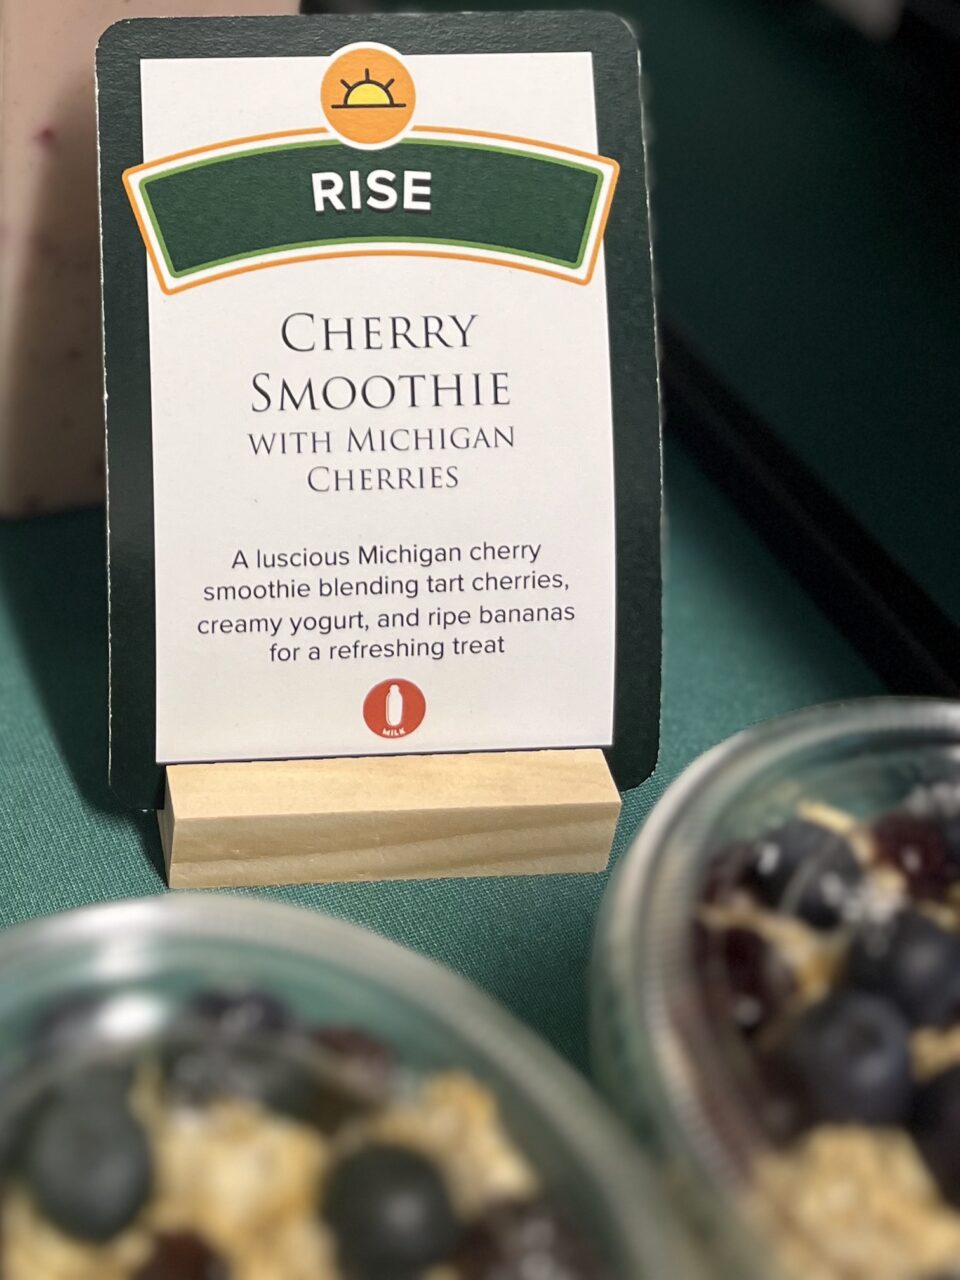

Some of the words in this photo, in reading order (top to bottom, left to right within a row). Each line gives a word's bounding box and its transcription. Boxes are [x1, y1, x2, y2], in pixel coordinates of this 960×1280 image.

[312, 170, 433, 213] RISE
[281, 312, 477, 353] CHERRY
[251, 372, 510, 413] SMOOTHIE
[248, 431, 331, 455] WITH
[347, 426, 514, 453] MICHIGAN
[307, 466, 459, 492] CHERRIES
[231, 549, 249, 569] A
[257, 547, 350, 569] luscious
[358, 544, 461, 568] Michigan
[469, 541, 542, 564] cherry
[203, 579, 311, 601] smoothie
[319, 575, 419, 599] blending
[426, 574, 465, 594] tart
[471, 570, 569, 592] cherries,
[197, 617, 283, 637] creamy
[289, 610, 369, 637] yogurt,
[377, 607, 419, 628] and
[428, 607, 471, 630] ripe
[479, 605, 575, 624] bananas
[269, 642, 301, 662] for
[308, 646, 321, 661] a
[329, 638, 445, 661] refreshing
[452, 635, 505, 655] treat
[382, 727, 406, 736] MILK
